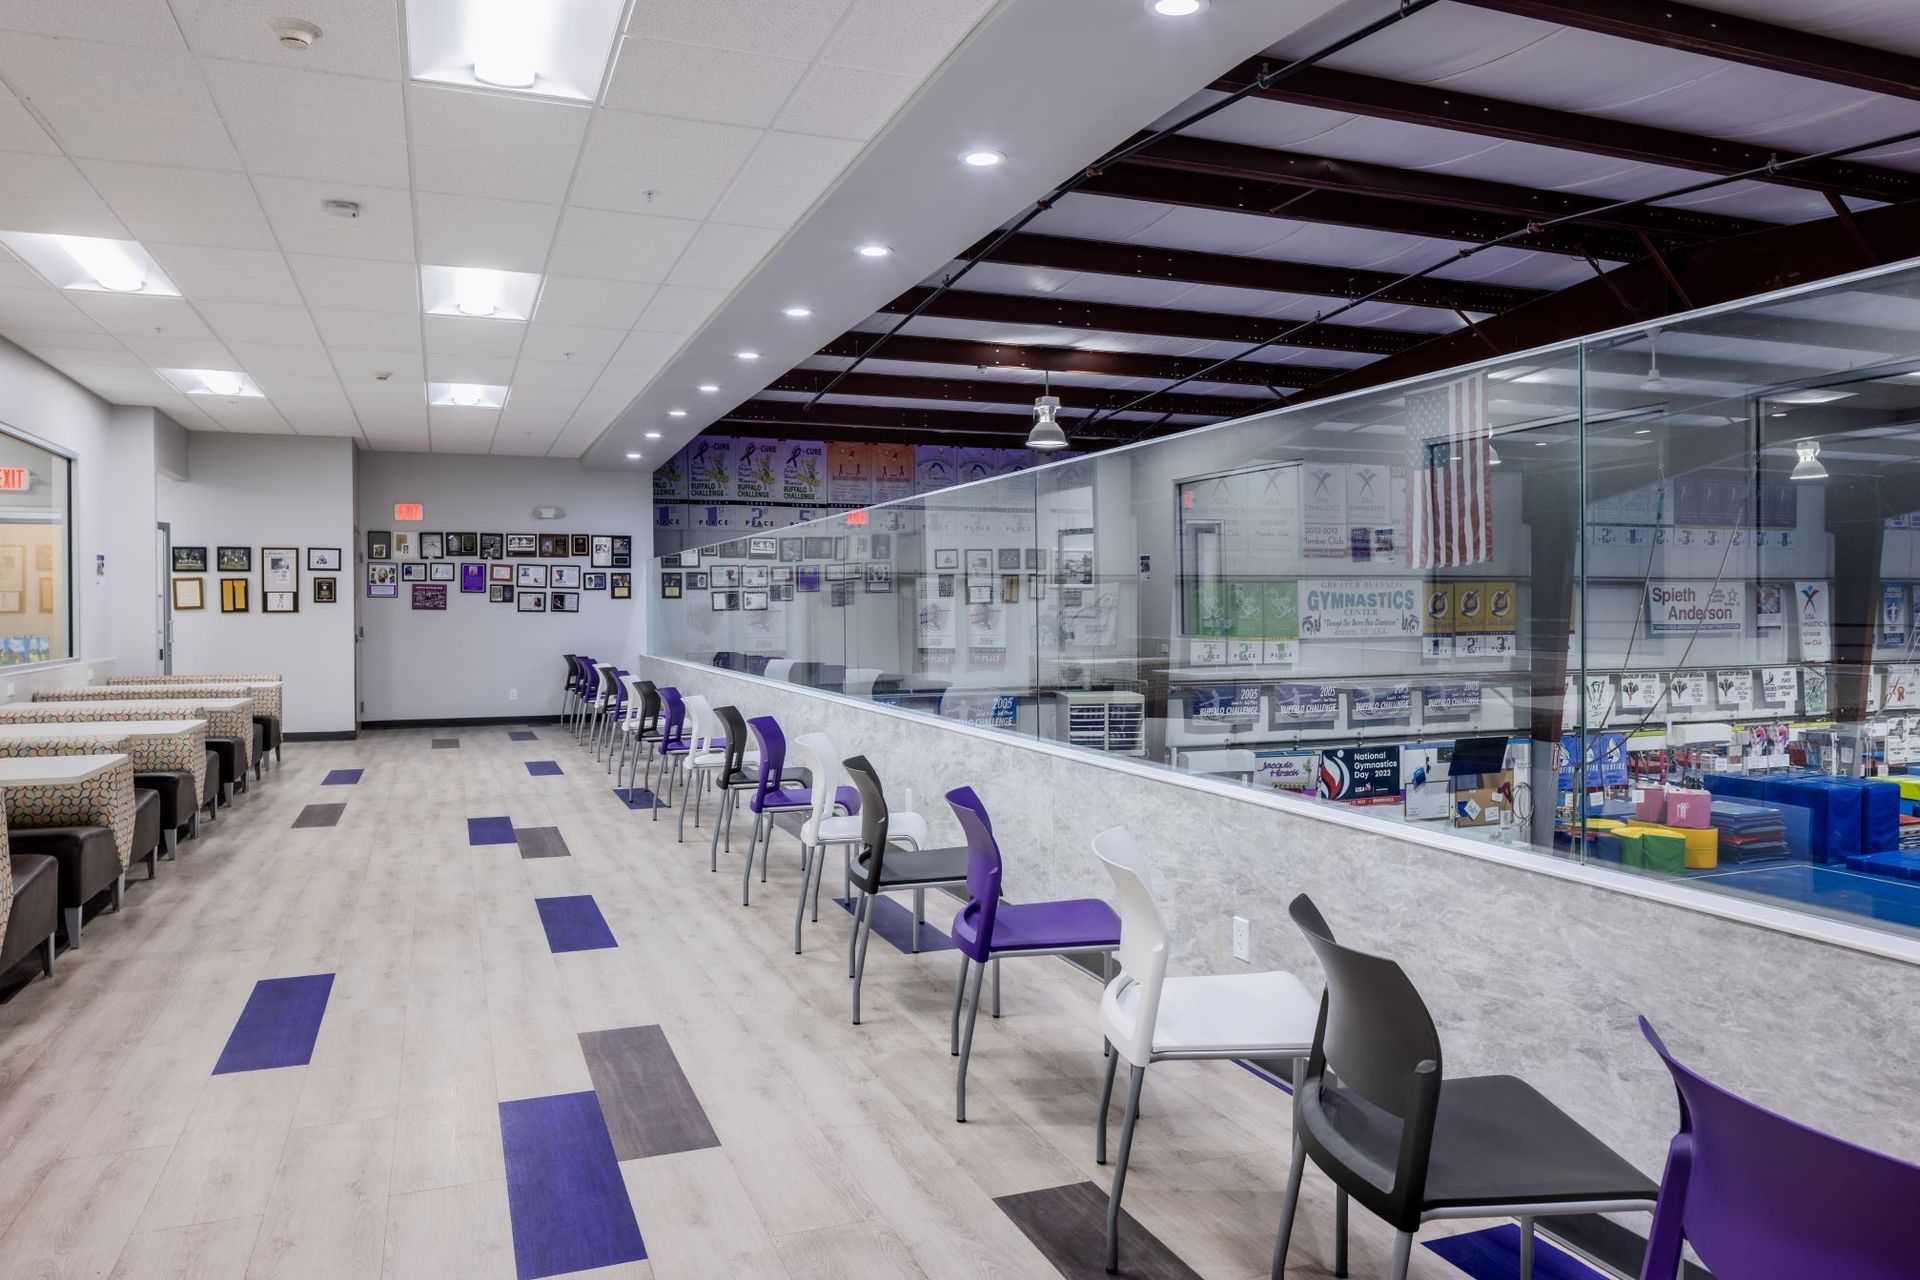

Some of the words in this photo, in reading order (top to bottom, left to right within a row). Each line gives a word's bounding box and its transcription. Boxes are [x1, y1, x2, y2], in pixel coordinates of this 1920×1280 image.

[714, 442, 730, 451] CURE
[761, 445, 776, 453] CURE
[806, 448, 822, 456] CURE
[691, 489, 724, 497] CHALLENGE
[737, 490, 770, 498] CHALLENGE
[783, 492, 815, 500] CHALLENGE
[1321, 581, 1359, 589] GREATER
[1308, 590, 1415, 611] GYMNASTICS
[1652, 587, 1696, 605] Spieth
[1668, 606, 1732, 620] Anderson
[1464, 681, 1479, 690] 2005
[1241, 689, 1258, 700] 2005
[1320, 686, 1336, 697] 2005
[993, 697, 1013, 709] 2005
[1356, 702, 1379, 711] BUFFALO
[1380, 701, 1409, 710] CHALLENGE
[1429, 698, 1451, 707] BUFFALO
[1452, 697, 1480, 705] CHALLENGE
[1200, 707, 1225, 716] BUFFALO
[1226, 706, 1258, 715] CHALLENGE
[1280, 705, 1305, 713] BUFFALO
[1306, 703, 1338, 712] CHALLENGE
[975, 717, 1013, 727] CHALLENGE
[1354, 752, 1386, 760] National
[1354, 760, 1398, 771] Gymnastics
[1586, 763, 1599, 771] FIRE
[1354, 770, 1369, 779] Day
[1374, 769, 1391, 778] 2022
